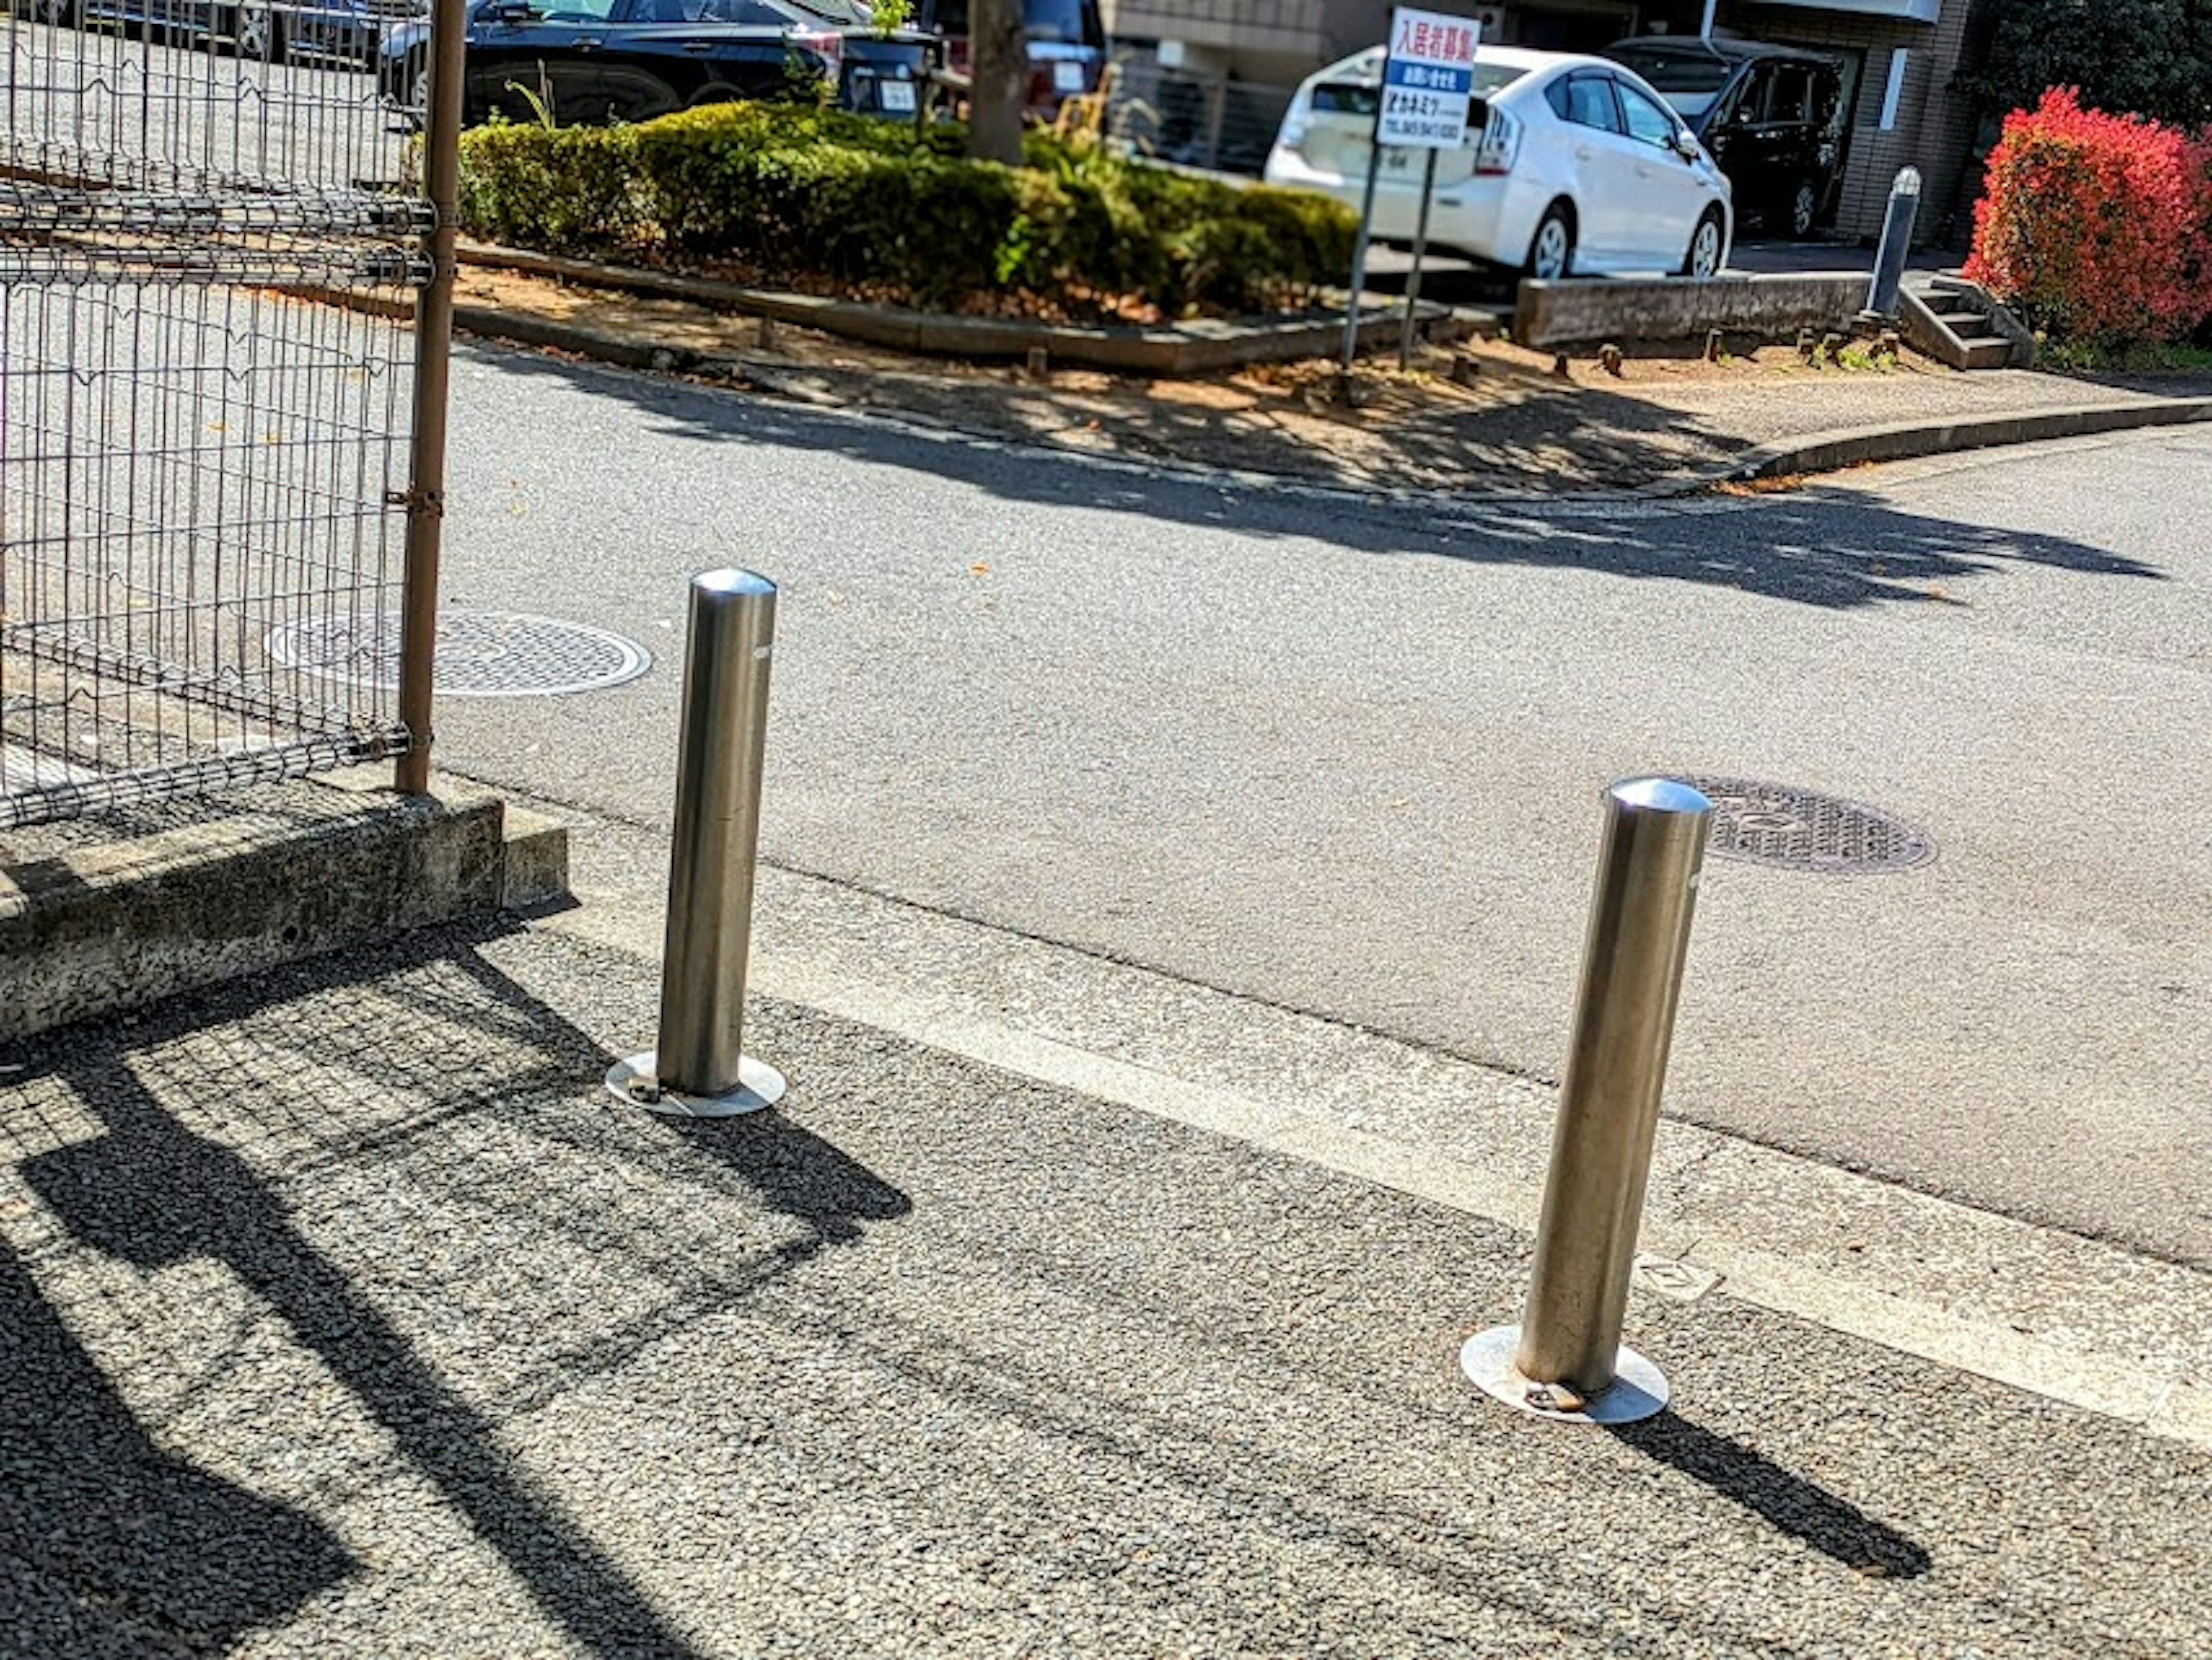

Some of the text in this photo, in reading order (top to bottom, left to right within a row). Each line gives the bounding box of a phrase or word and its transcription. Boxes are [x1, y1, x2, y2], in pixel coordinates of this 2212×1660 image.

[1396, 20, 1472, 62] 入居者募集
